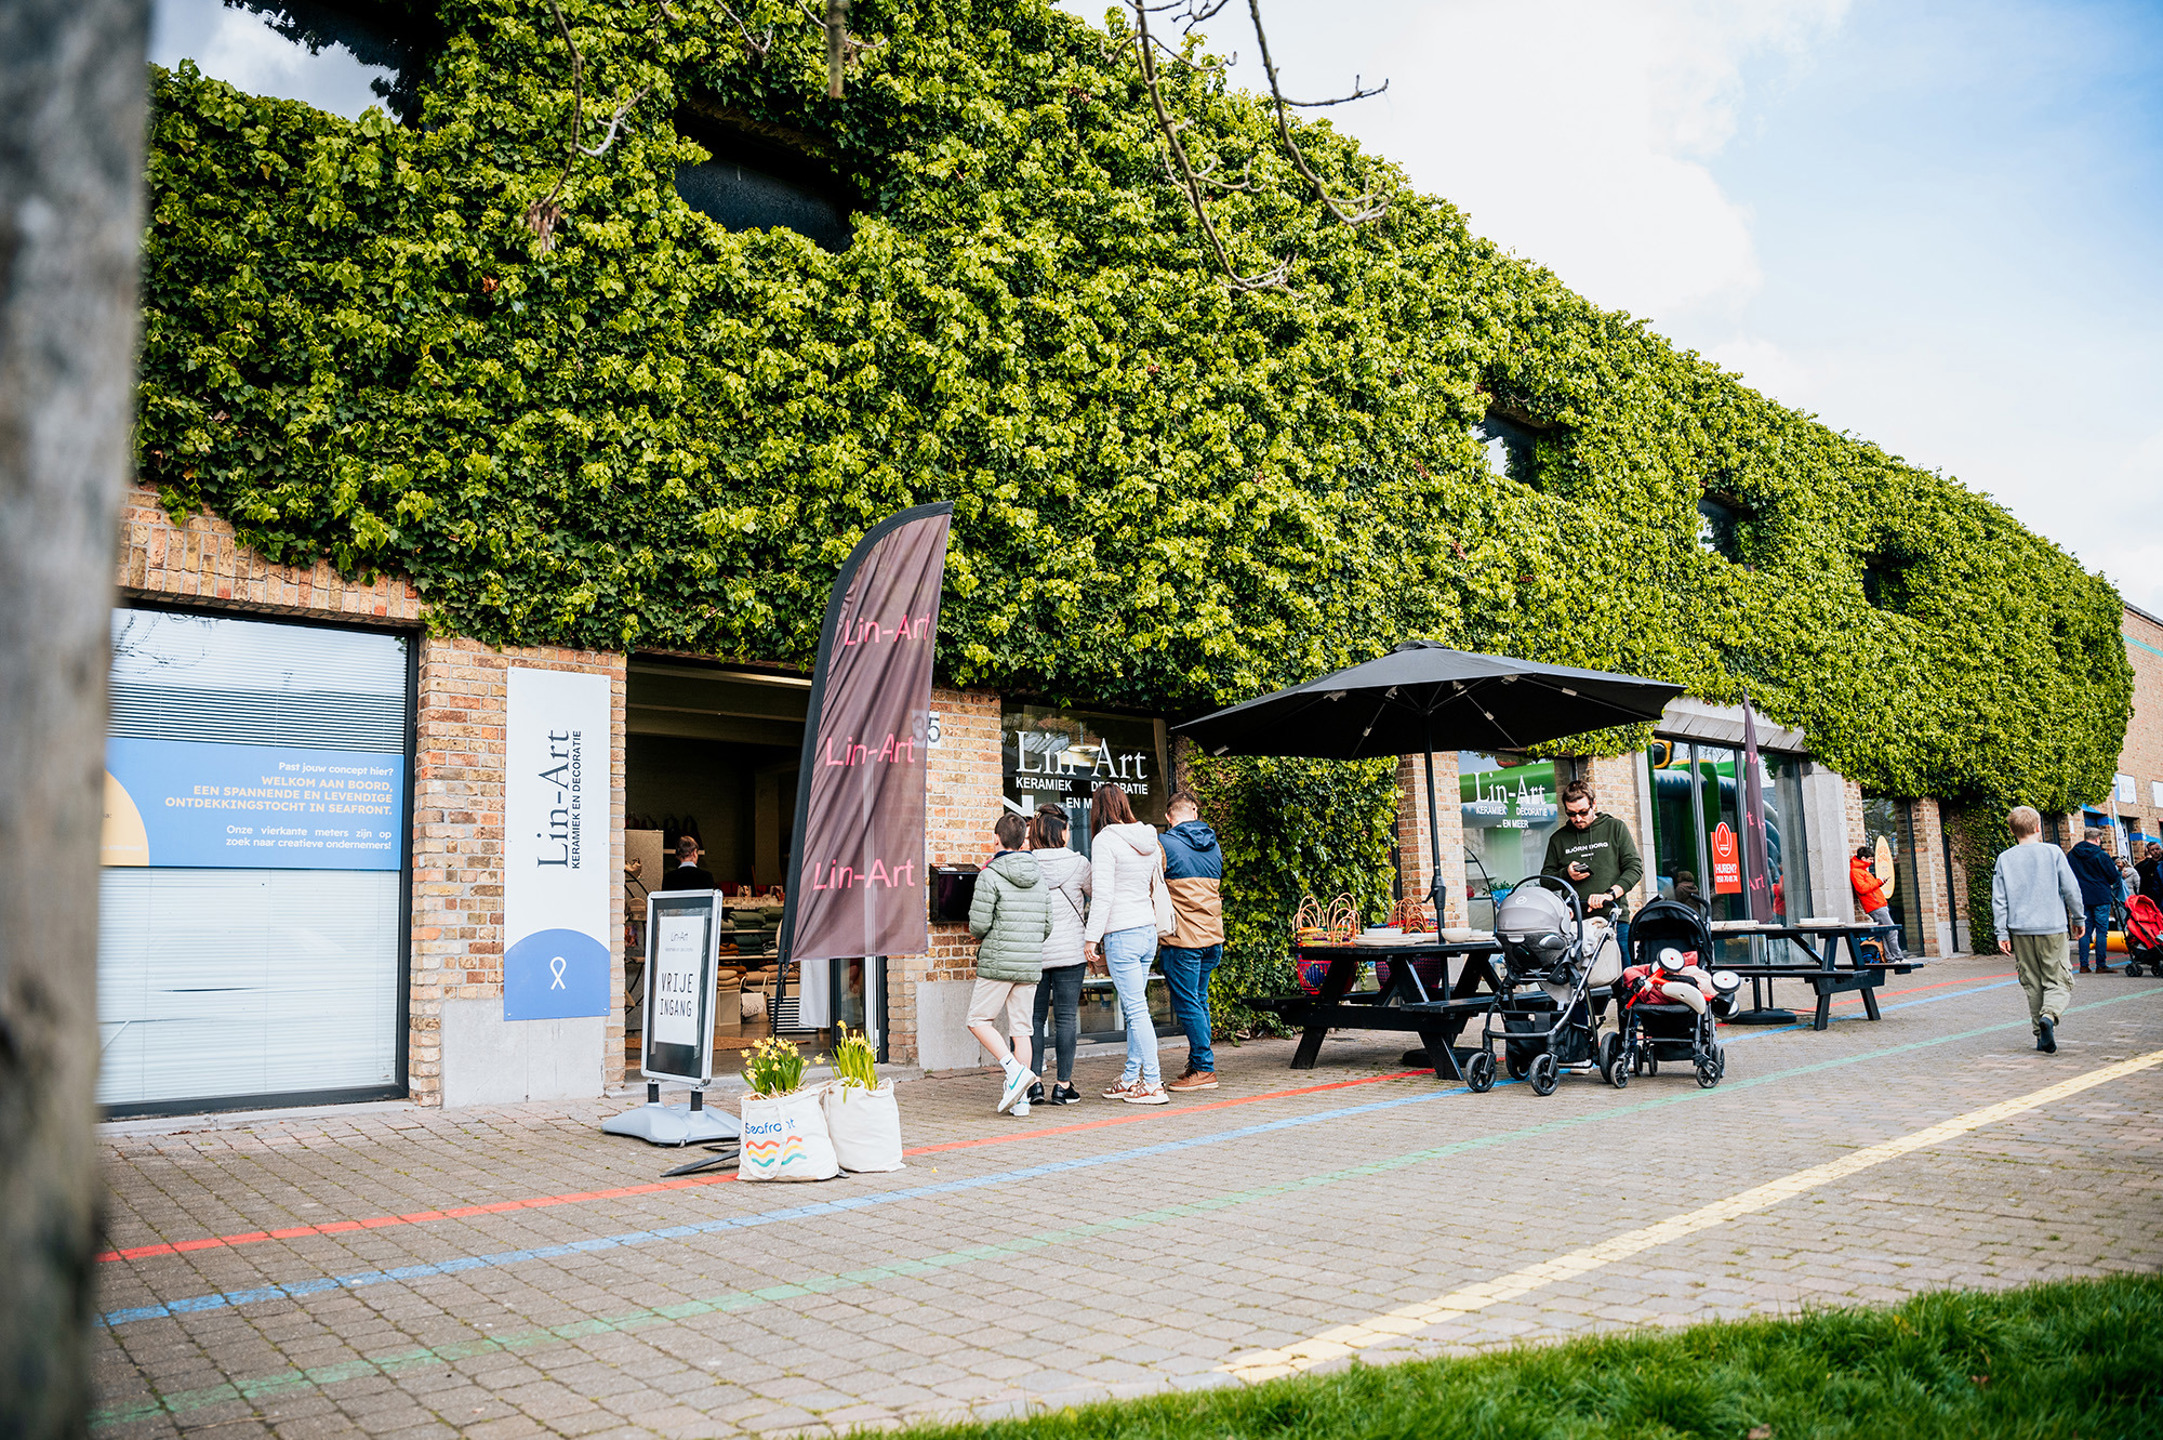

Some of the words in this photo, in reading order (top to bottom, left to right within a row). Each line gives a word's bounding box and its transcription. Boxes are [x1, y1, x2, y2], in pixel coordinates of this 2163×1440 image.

[844, 613, 930, 646] Lin-Art
[825, 733, 915, 766] Lin-Art
[1015, 730, 1148, 780] Lin-Art
[279, 762, 300, 772] Past
[302, 763, 327, 774] jouw
[328, 766, 368, 776] concept
[369, 766, 394, 777] hier?
[572, 730, 582, 792] DECORATIE
[261, 776, 316, 788] WELKOM
[319, 778, 344, 789] AAN
[348, 780, 393, 792] BOORD,
[1016, 776, 1073, 792] KERAMIEK
[1091, 781, 1149, 795] DRATIE
[1473, 771, 1546, 805] Lin-Art
[193, 785, 219, 796] EEN
[223, 786, 300, 799] SPANNENDE
[304, 790, 320, 800] EN
[324, 791, 393, 804] LEVENDIGE
[537, 729, 569, 868] Lin-Art
[572, 795, 580, 810] EN
[1066, 797, 1081, 809] EN
[165, 797, 306, 812] ONTDEKKINGSTOCHT
[309, 803, 325, 812] IN
[328, 803, 393, 816] SEAFRONT.
[226, 825, 253, 835] Onze
[260, 826, 308, 836] vierkante
[314, 829, 349, 838] meters
[356, 828, 372, 840] zijn
[379, 831, 392, 841] op
[572, 813, 580, 869] KERAMIEK
[226, 838, 251, 847] zoek
[253, 839, 276, 847] naar
[277, 838, 323, 849] creatieve
[325, 840, 392, 850] ondernemers!
[813, 859, 915, 890] Lin-Art
[661, 972, 694, 994] VRIJE
[660, 998, 692, 1018] INGANG
